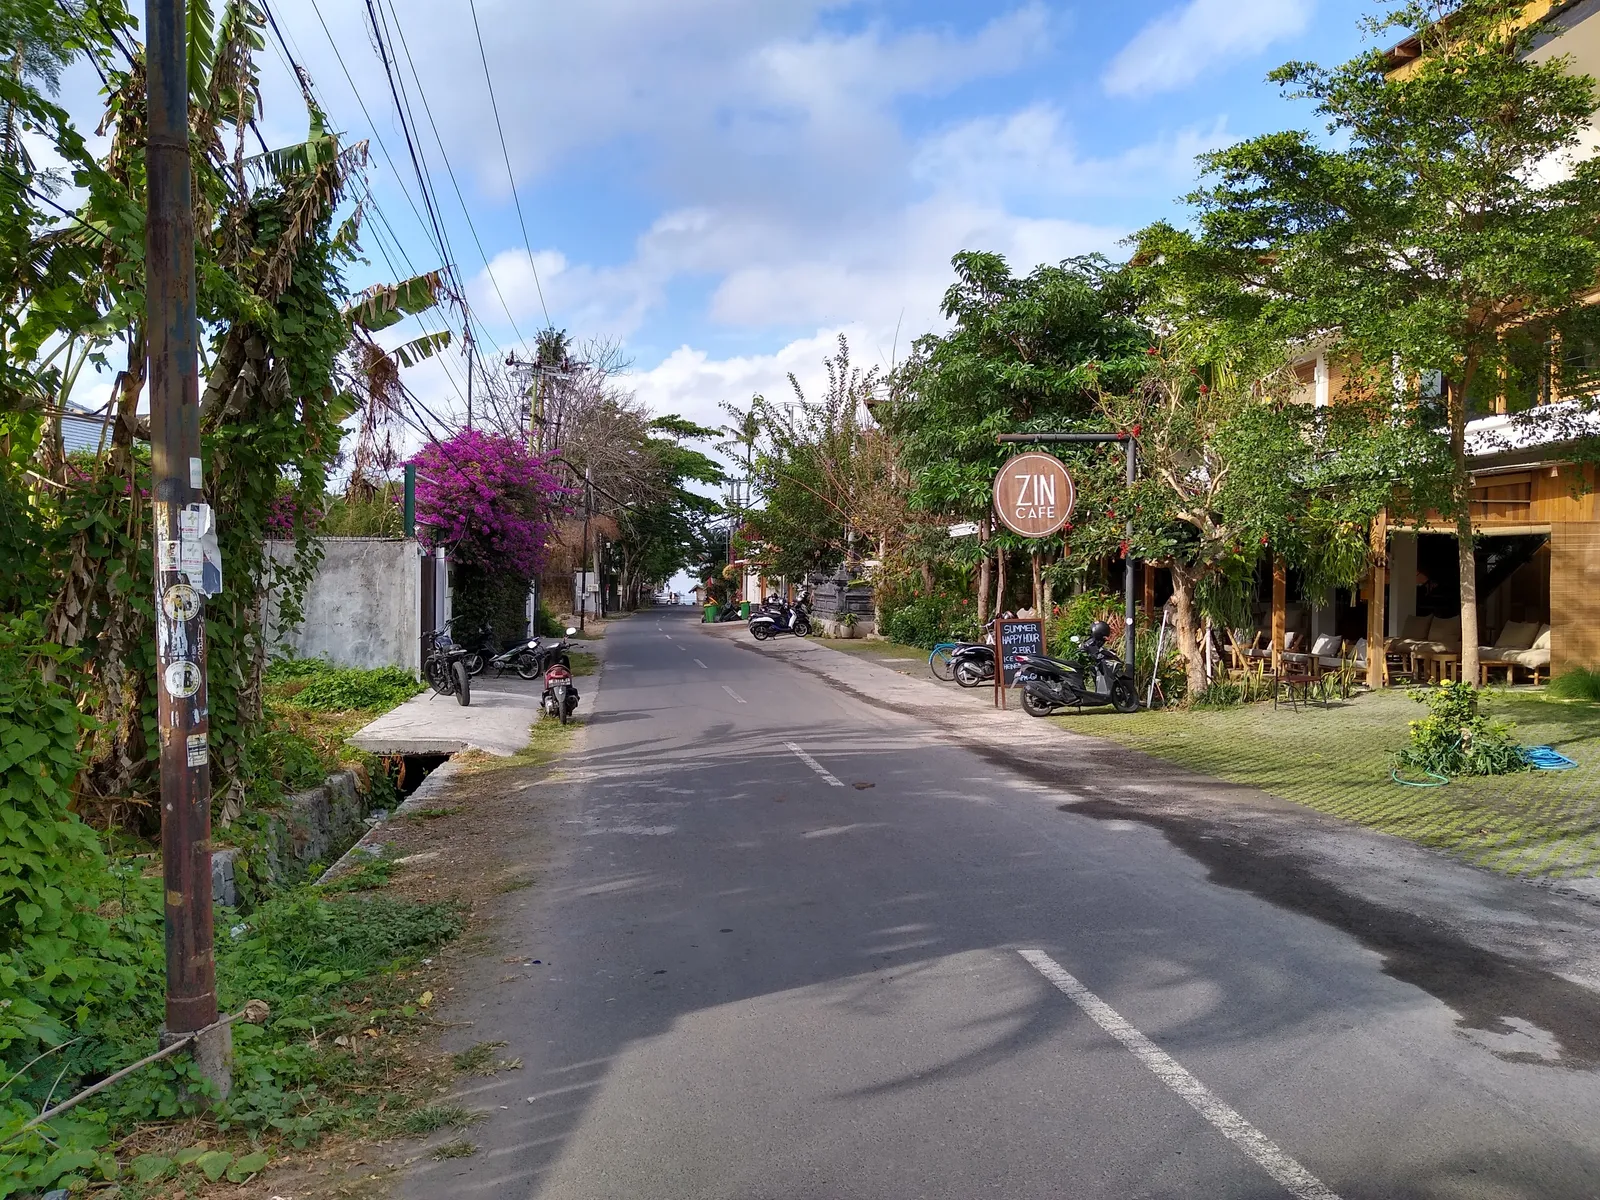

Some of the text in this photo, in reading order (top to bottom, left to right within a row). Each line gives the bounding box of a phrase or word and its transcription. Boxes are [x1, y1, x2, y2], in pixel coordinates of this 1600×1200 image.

[1014, 474, 1055, 506] ZIN
[1015, 506, 1055, 519] CAFE
[1003, 624, 1038, 634] SUMMER
[1002, 633, 1041, 645] HAPPY HOUR
[1011, 646, 1018, 654] 2
[1018, 646, 1031, 654] FOR
[1003, 655, 1014, 663] ICE
